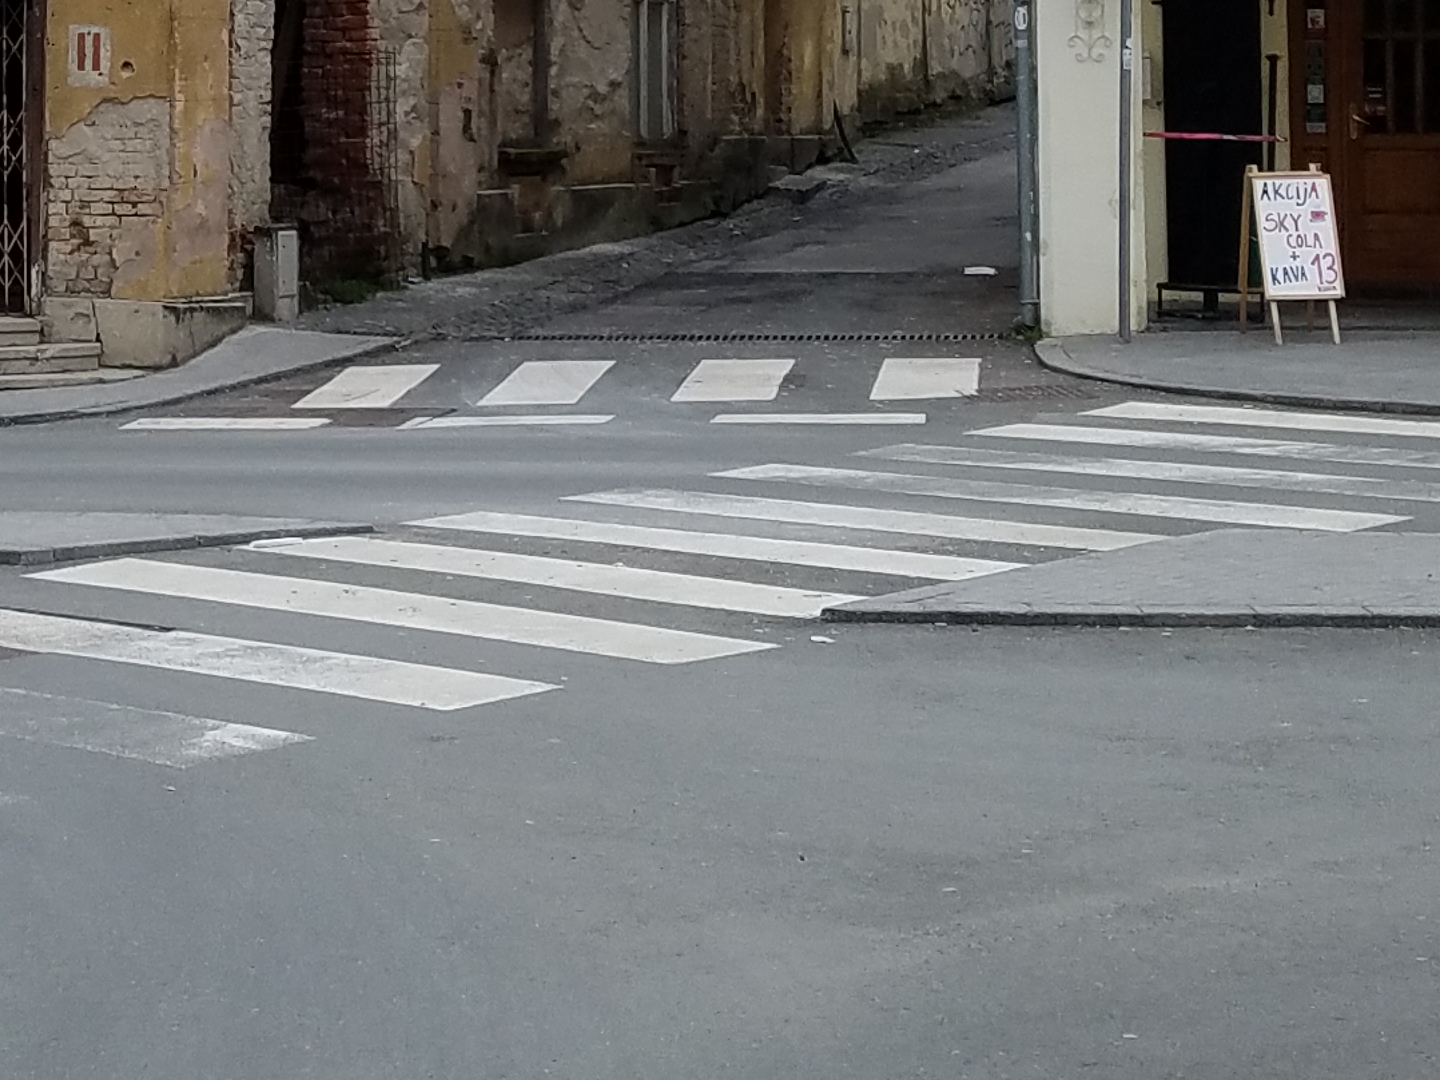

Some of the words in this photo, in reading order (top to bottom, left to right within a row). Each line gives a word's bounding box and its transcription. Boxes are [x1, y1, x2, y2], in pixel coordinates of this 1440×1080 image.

[1263, 212, 1302, 233] SKY
[1286, 232, 1324, 250] COLA
[1270, 265, 1309, 286] KAVA
[1310, 252, 1338, 285] 13
